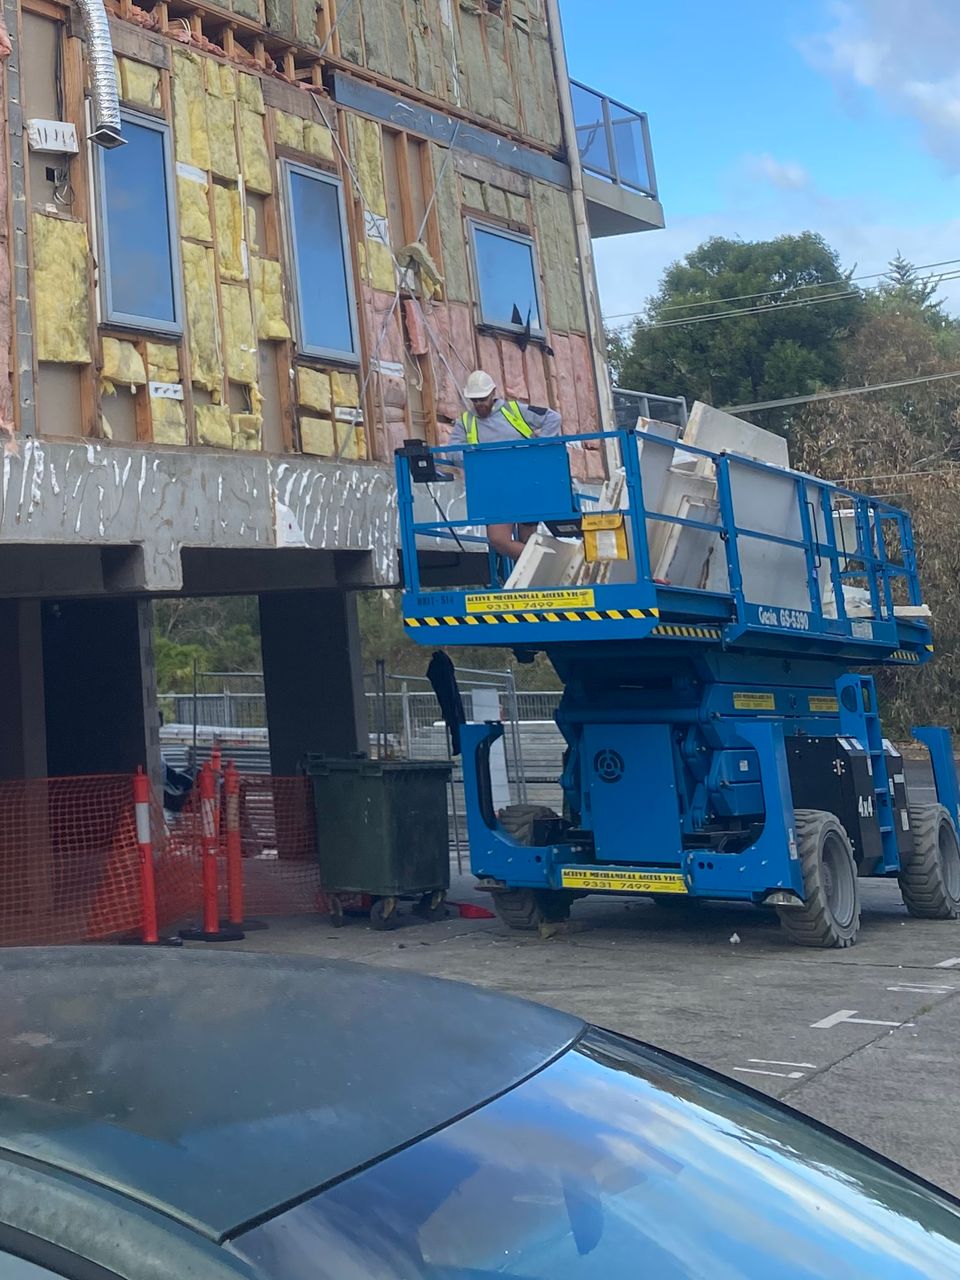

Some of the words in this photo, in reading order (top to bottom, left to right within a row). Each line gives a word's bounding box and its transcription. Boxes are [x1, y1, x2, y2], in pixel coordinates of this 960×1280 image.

[493, 593, 539, 601] MECHANICAL
[523, 601, 554, 609] 7499
[758, 606, 778, 626] Genie
[589, 872, 636, 880] MECHANICAL
[582, 880, 612, 888] 9331
[620, 882, 652, 890] 7499
